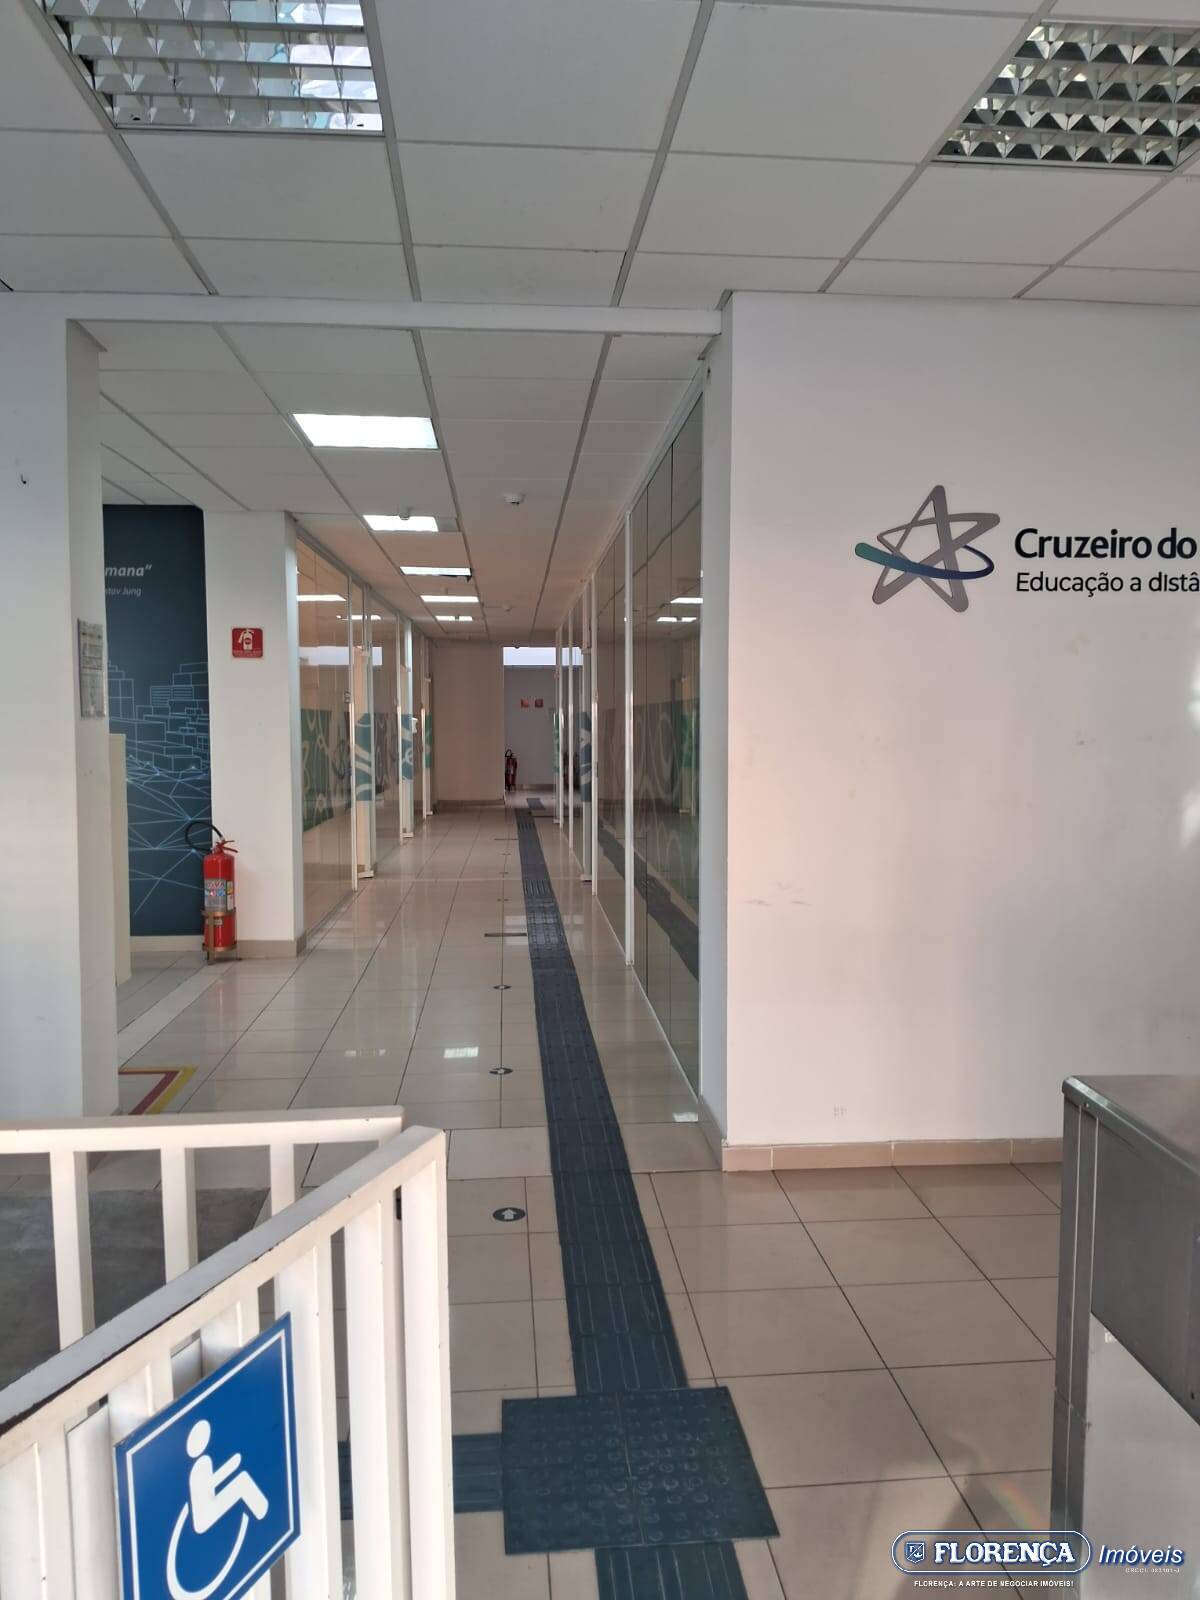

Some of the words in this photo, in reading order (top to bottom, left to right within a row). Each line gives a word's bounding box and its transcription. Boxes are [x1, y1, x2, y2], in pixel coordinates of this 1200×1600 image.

[1014, 527, 1153, 559] Cruzeiro
[1157, 527, 1198, 559] do
[1016, 571, 1124, 598] Educação
[1129, 576, 1142, 592] a
